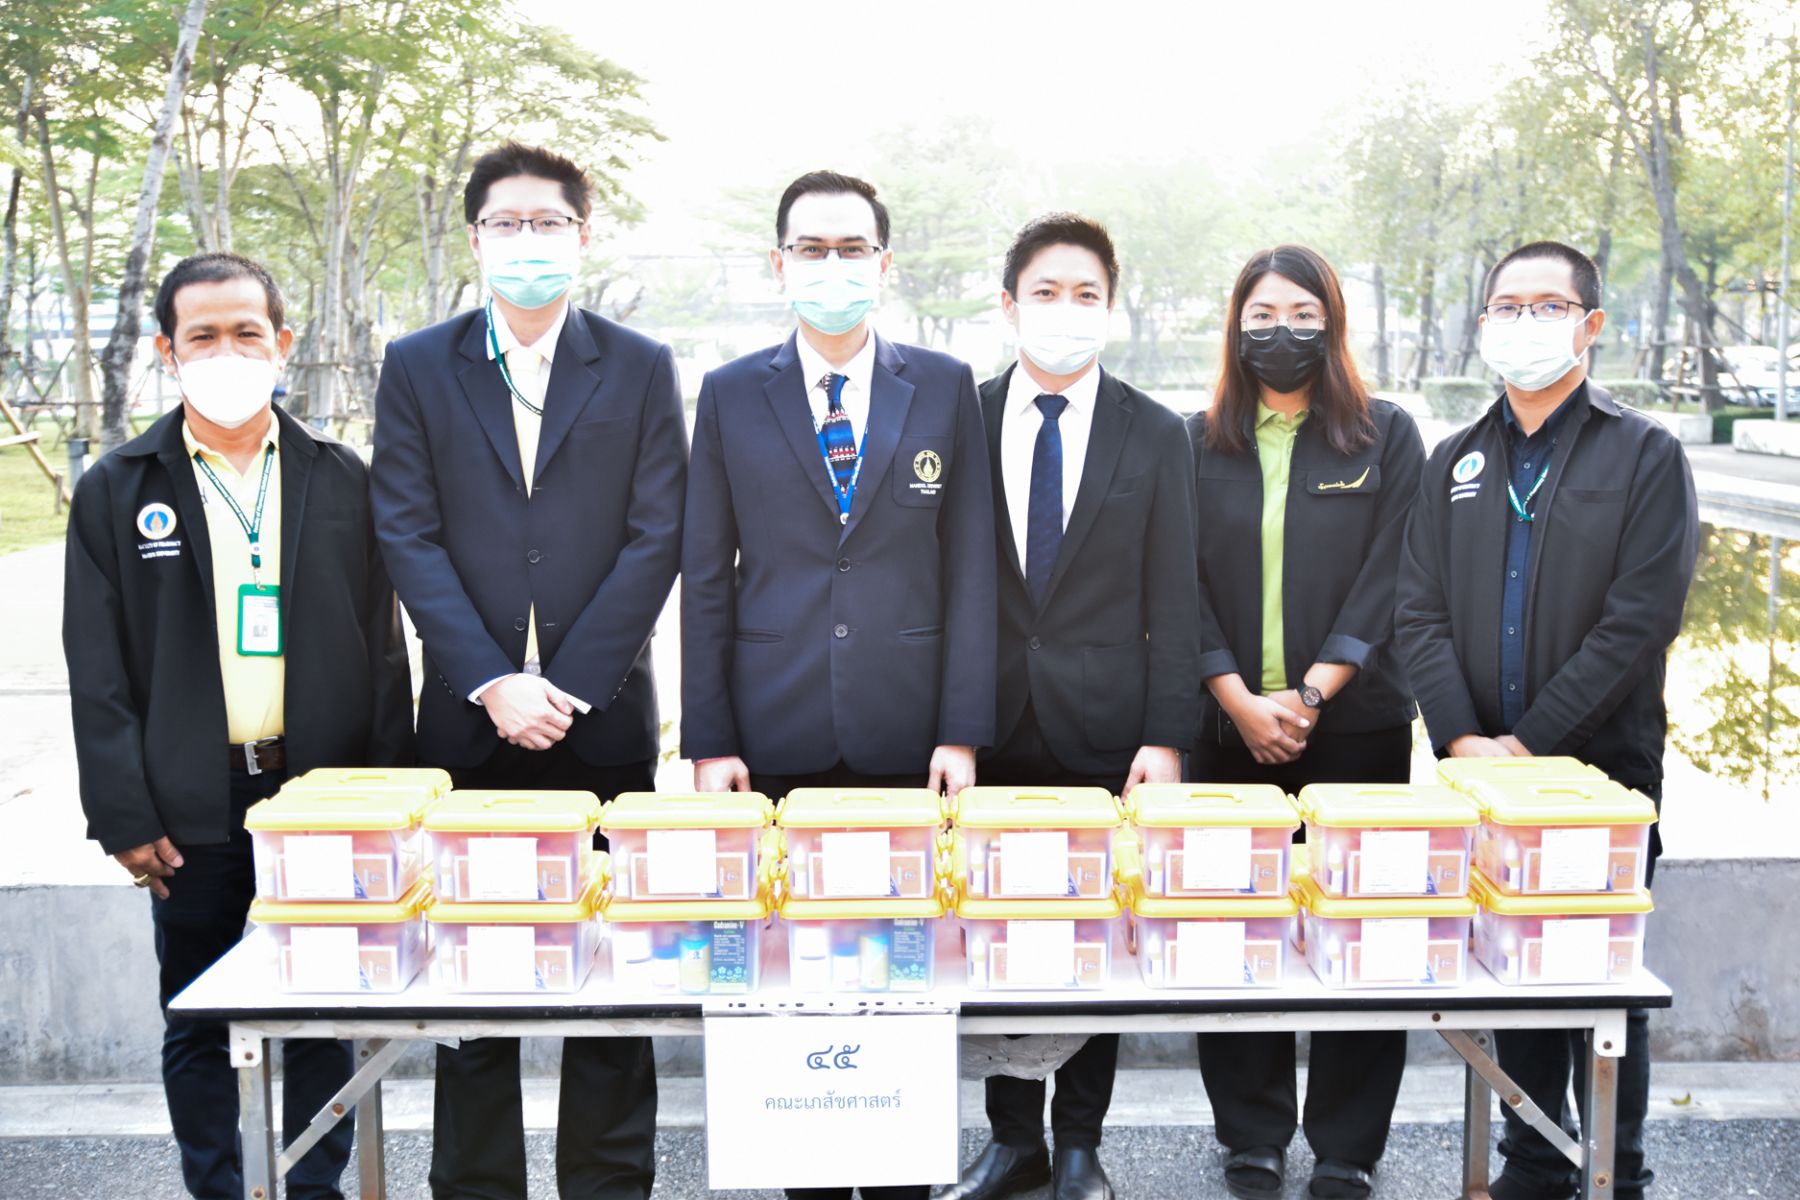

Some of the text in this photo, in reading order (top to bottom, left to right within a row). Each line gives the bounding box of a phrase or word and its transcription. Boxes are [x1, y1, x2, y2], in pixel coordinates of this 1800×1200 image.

[806, 1043, 860, 1070] ๔๕
[765, 1089, 901, 1110] คณะเภสัชศาสตร์
